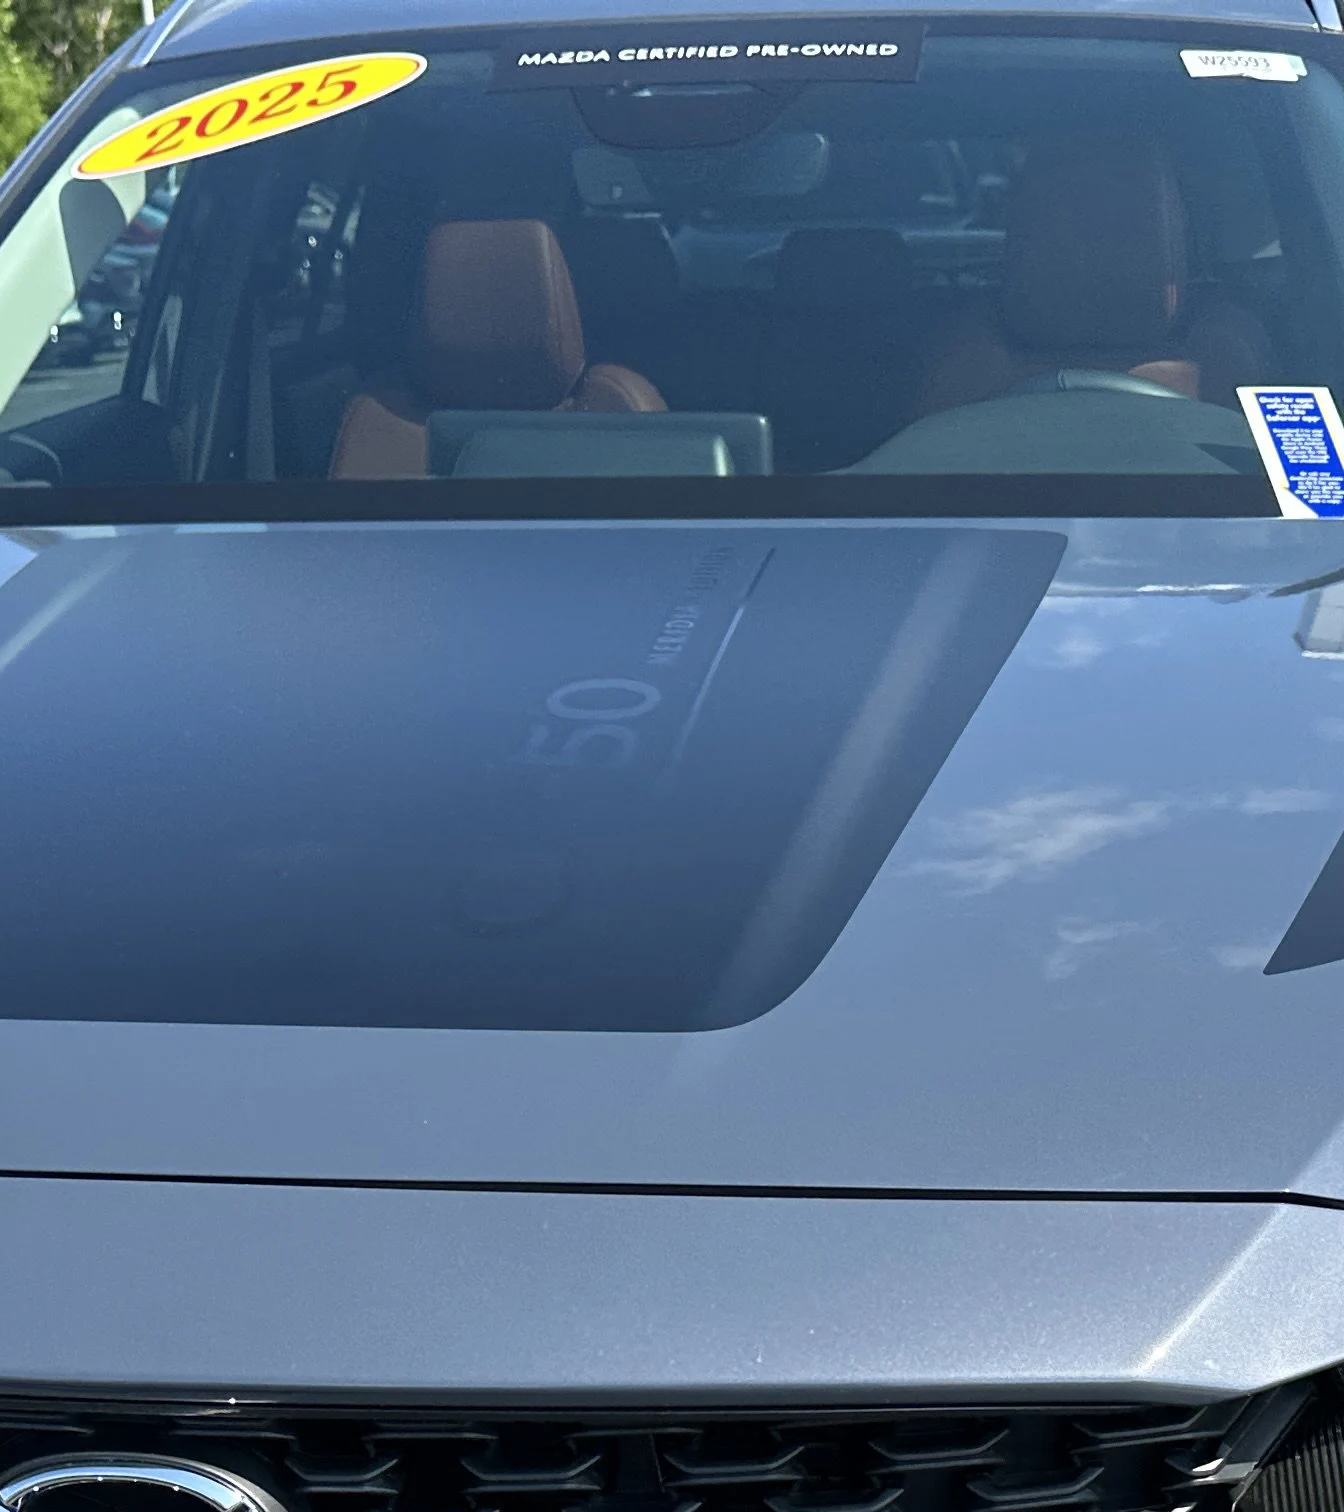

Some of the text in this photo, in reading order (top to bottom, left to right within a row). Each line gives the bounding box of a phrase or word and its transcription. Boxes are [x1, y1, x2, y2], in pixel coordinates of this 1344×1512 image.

[517, 43, 899, 67] MAZDA CERTIFIED PRE-OWNED
[134, 63, 365, 163] 2025
